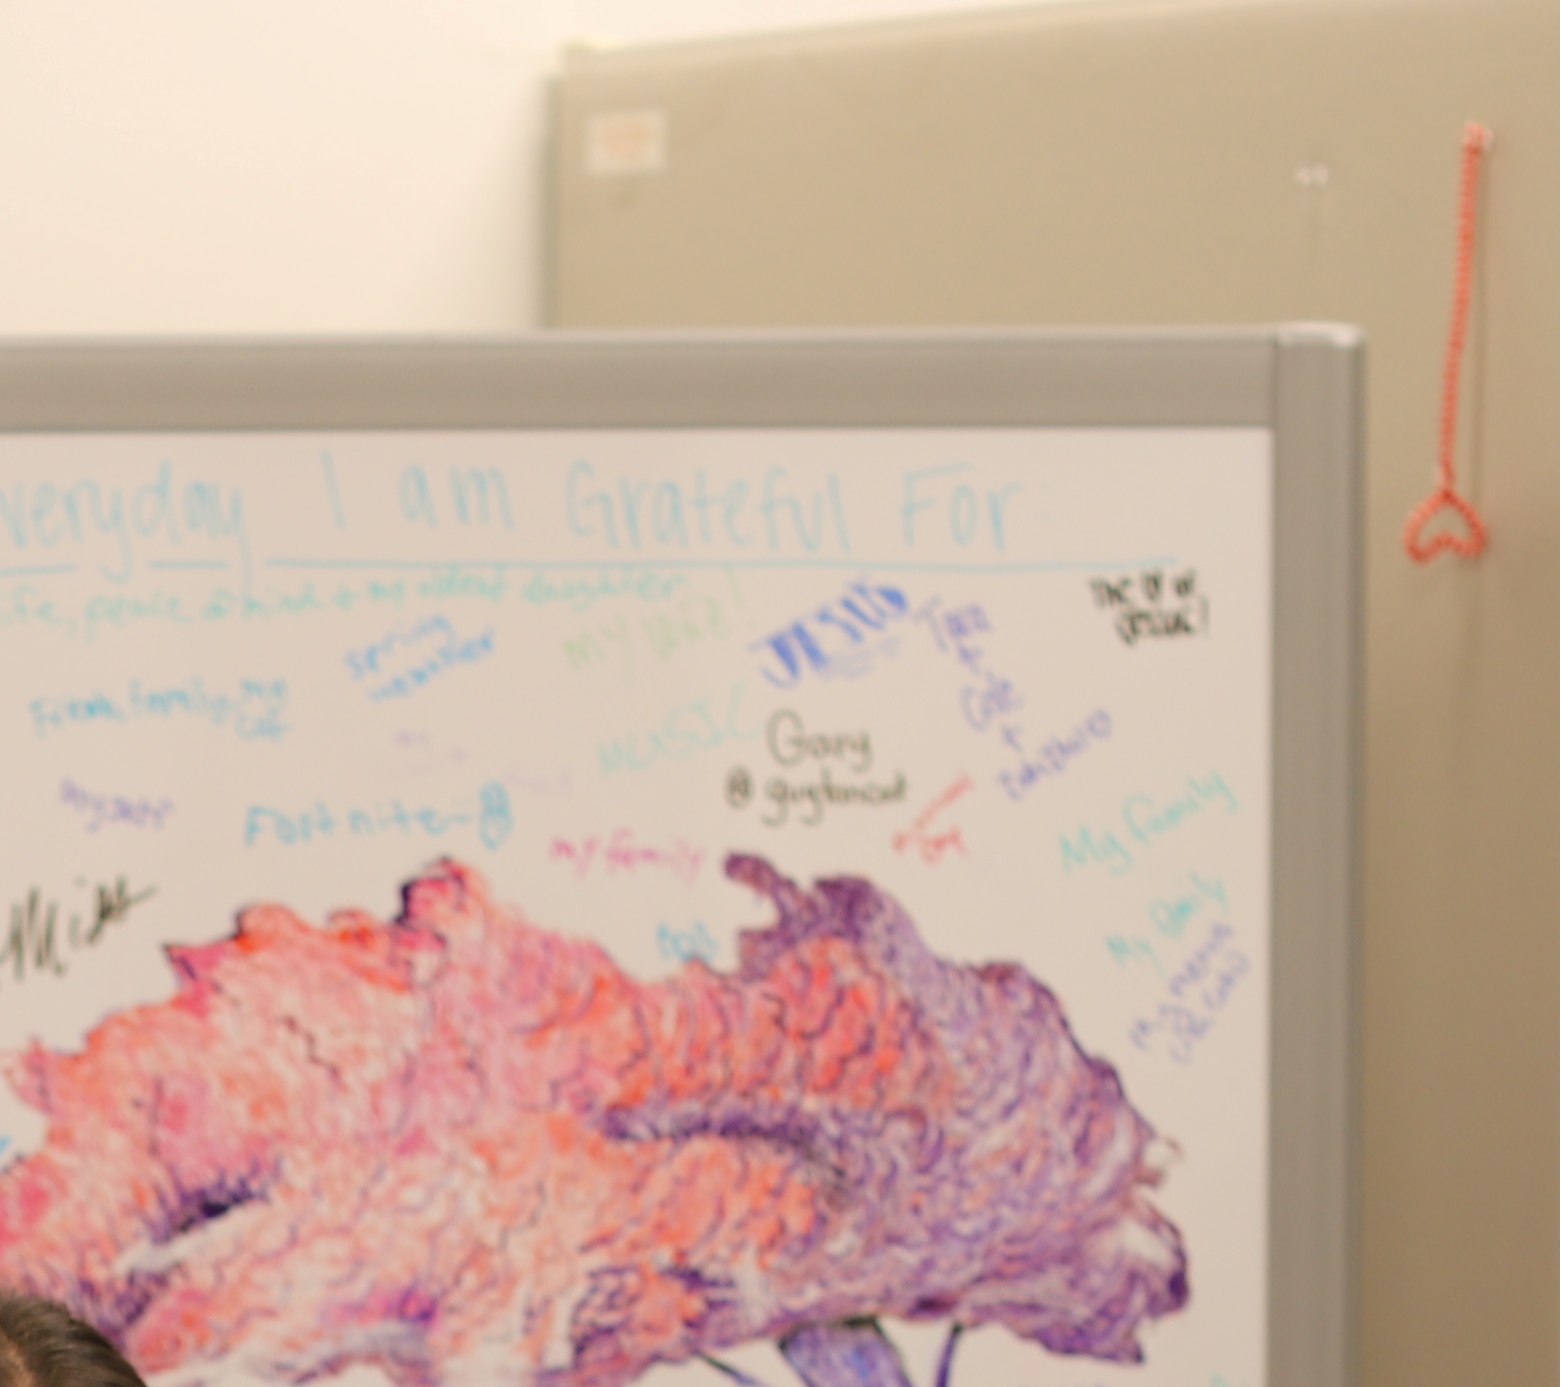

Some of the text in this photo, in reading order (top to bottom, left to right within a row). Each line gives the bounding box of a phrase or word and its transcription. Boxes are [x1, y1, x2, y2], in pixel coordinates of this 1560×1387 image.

[318, 448, 349, 531] I
[398, 463, 518, 531] am
[563, 456, 854, 555] Grateful
[767, 706, 872, 775] Gary
